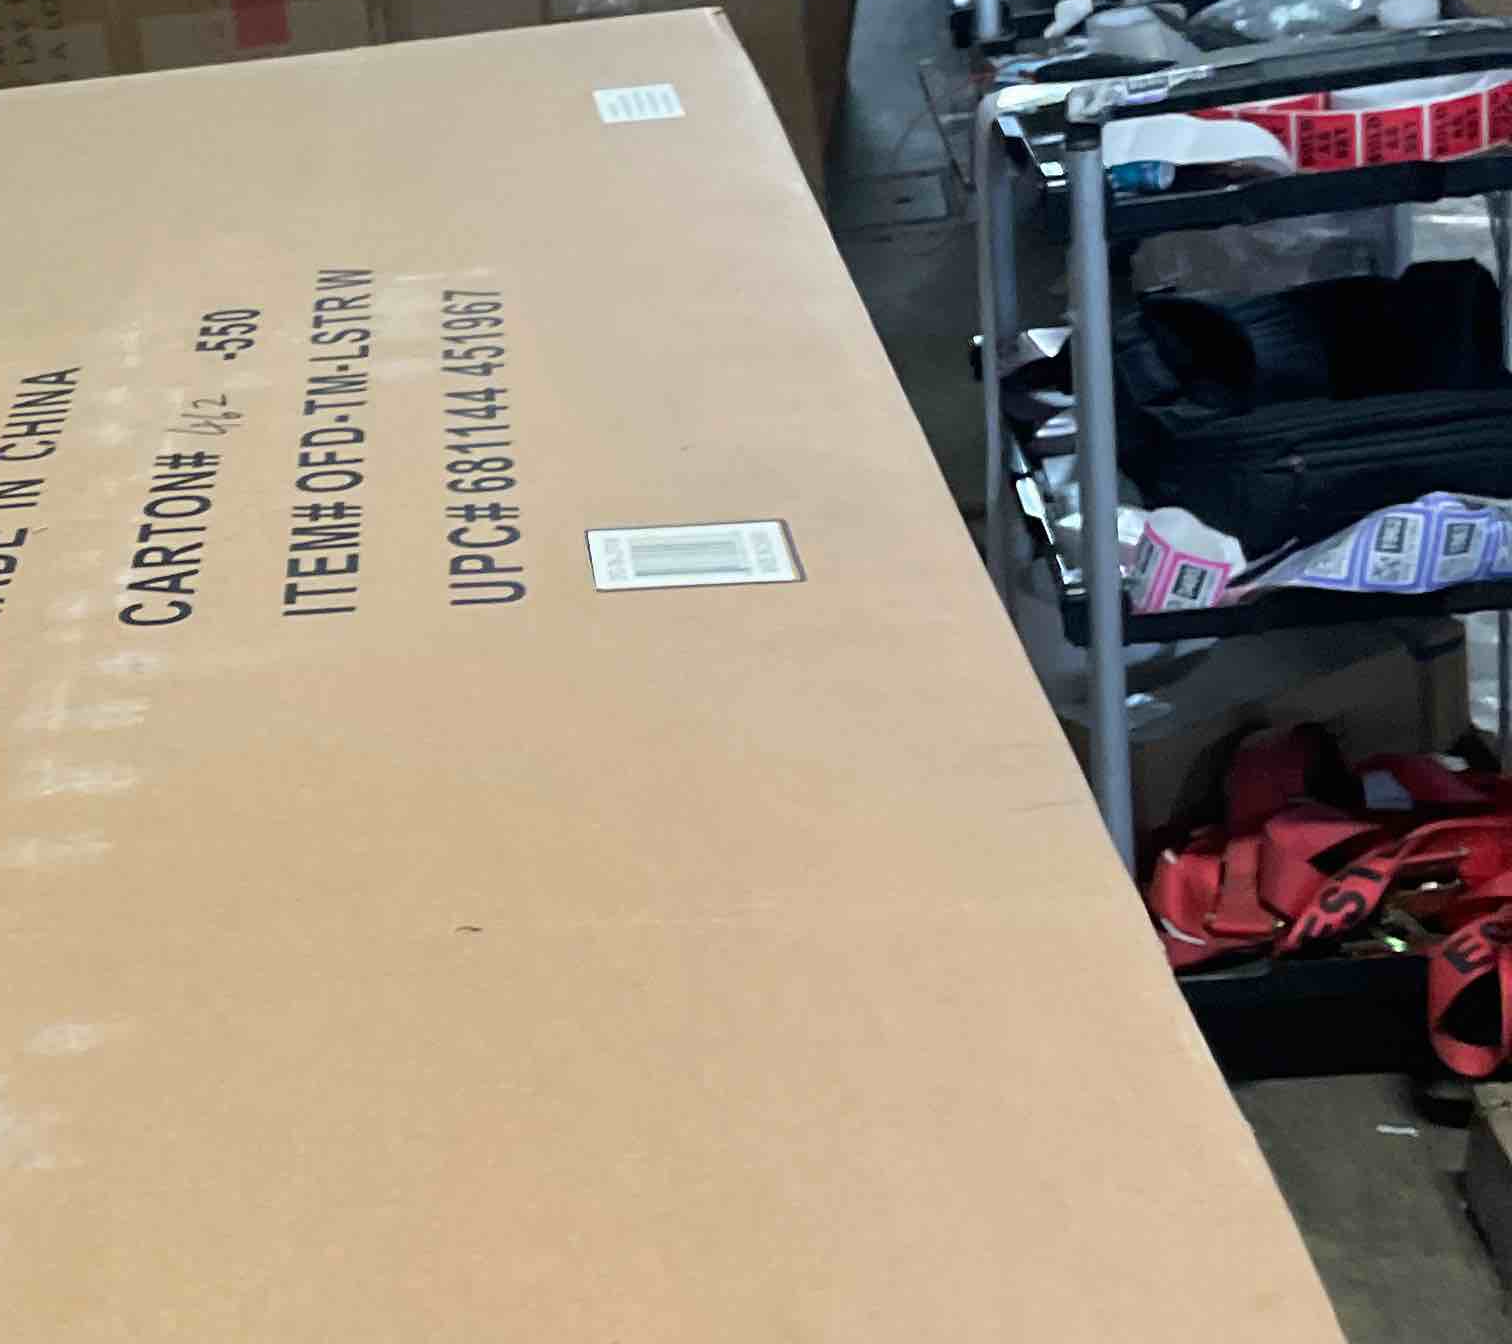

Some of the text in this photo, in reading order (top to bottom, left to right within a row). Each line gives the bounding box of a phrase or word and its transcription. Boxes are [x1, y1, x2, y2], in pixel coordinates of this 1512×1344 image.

[118, 451, 221, 628] CARTON#
[282, 501, 362, 616] ITEM#
[445, 502, 527, 607] UPC#
